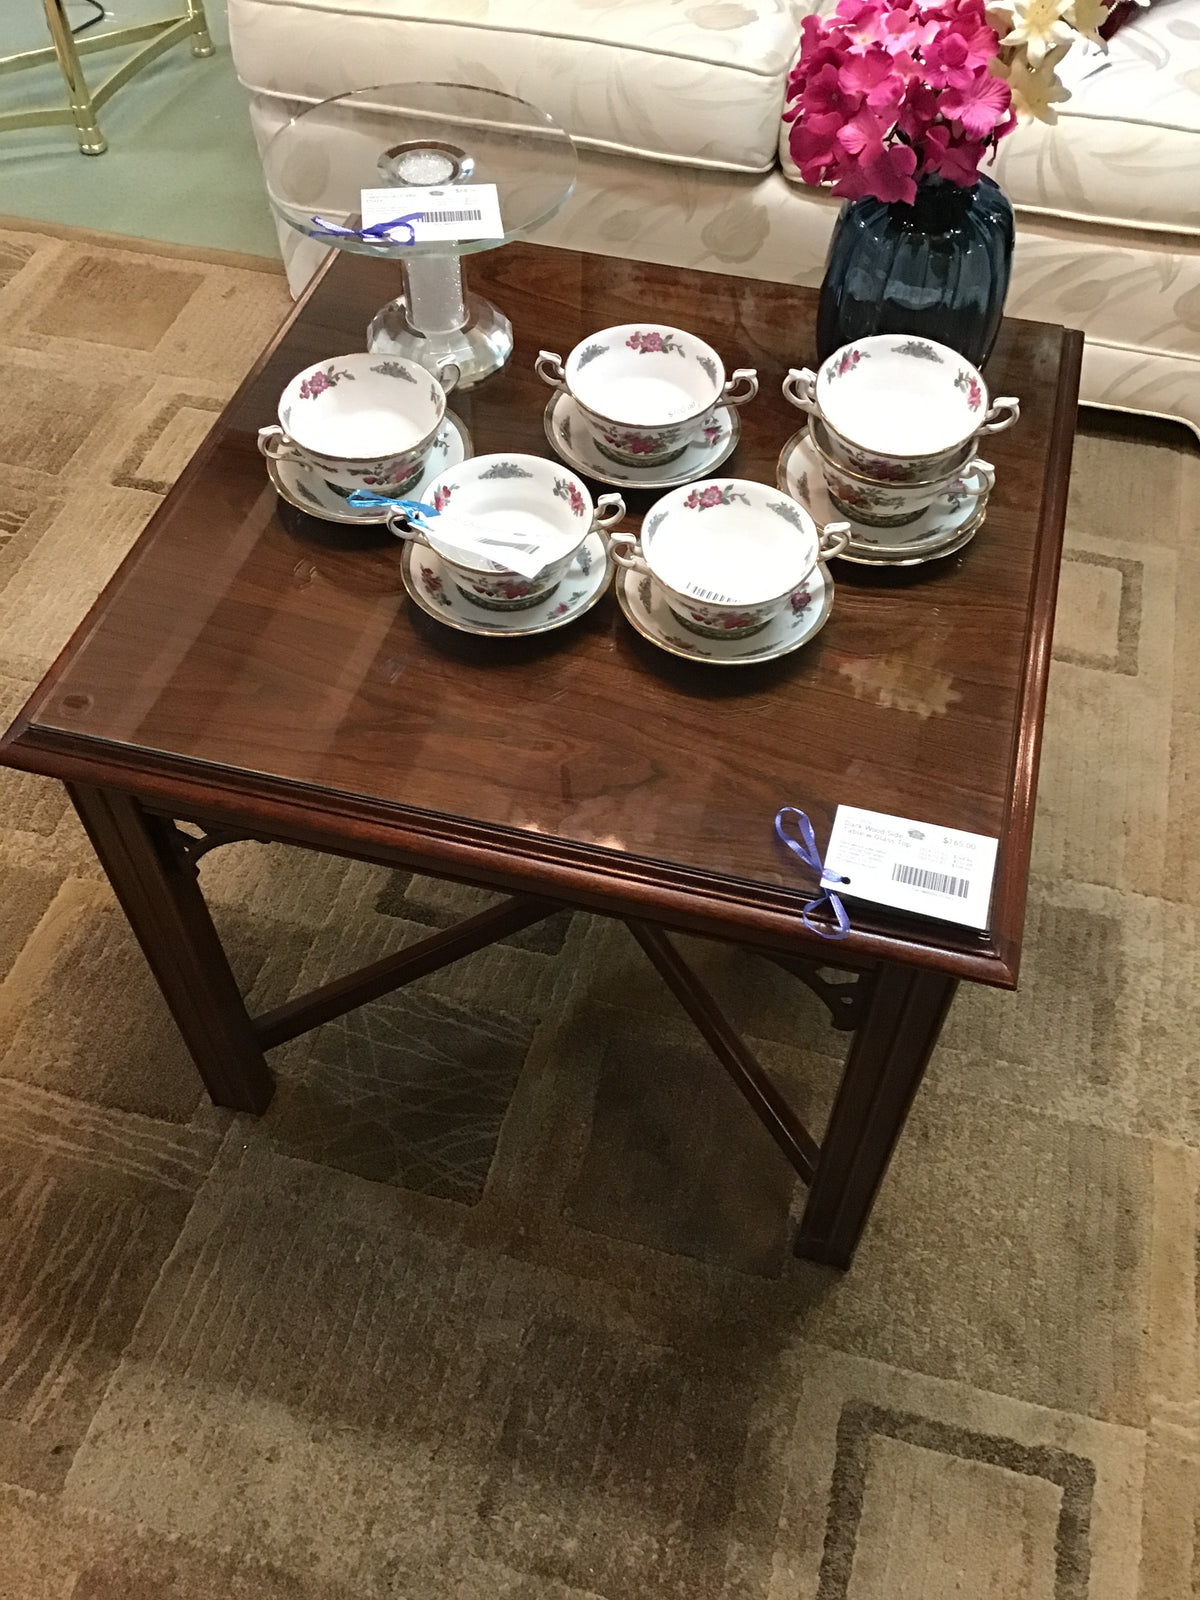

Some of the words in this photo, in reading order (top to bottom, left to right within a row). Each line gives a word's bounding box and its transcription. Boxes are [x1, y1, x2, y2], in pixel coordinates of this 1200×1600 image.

[844, 819, 862, 829] Dark
[865, 824, 885, 835] Wood
[887, 829, 904, 839] Side
[844, 825, 863, 836] Table
[874, 833, 896, 844] Glass
[898, 838, 912, 848] Top
[943, 836, 977, 850] $165.00
